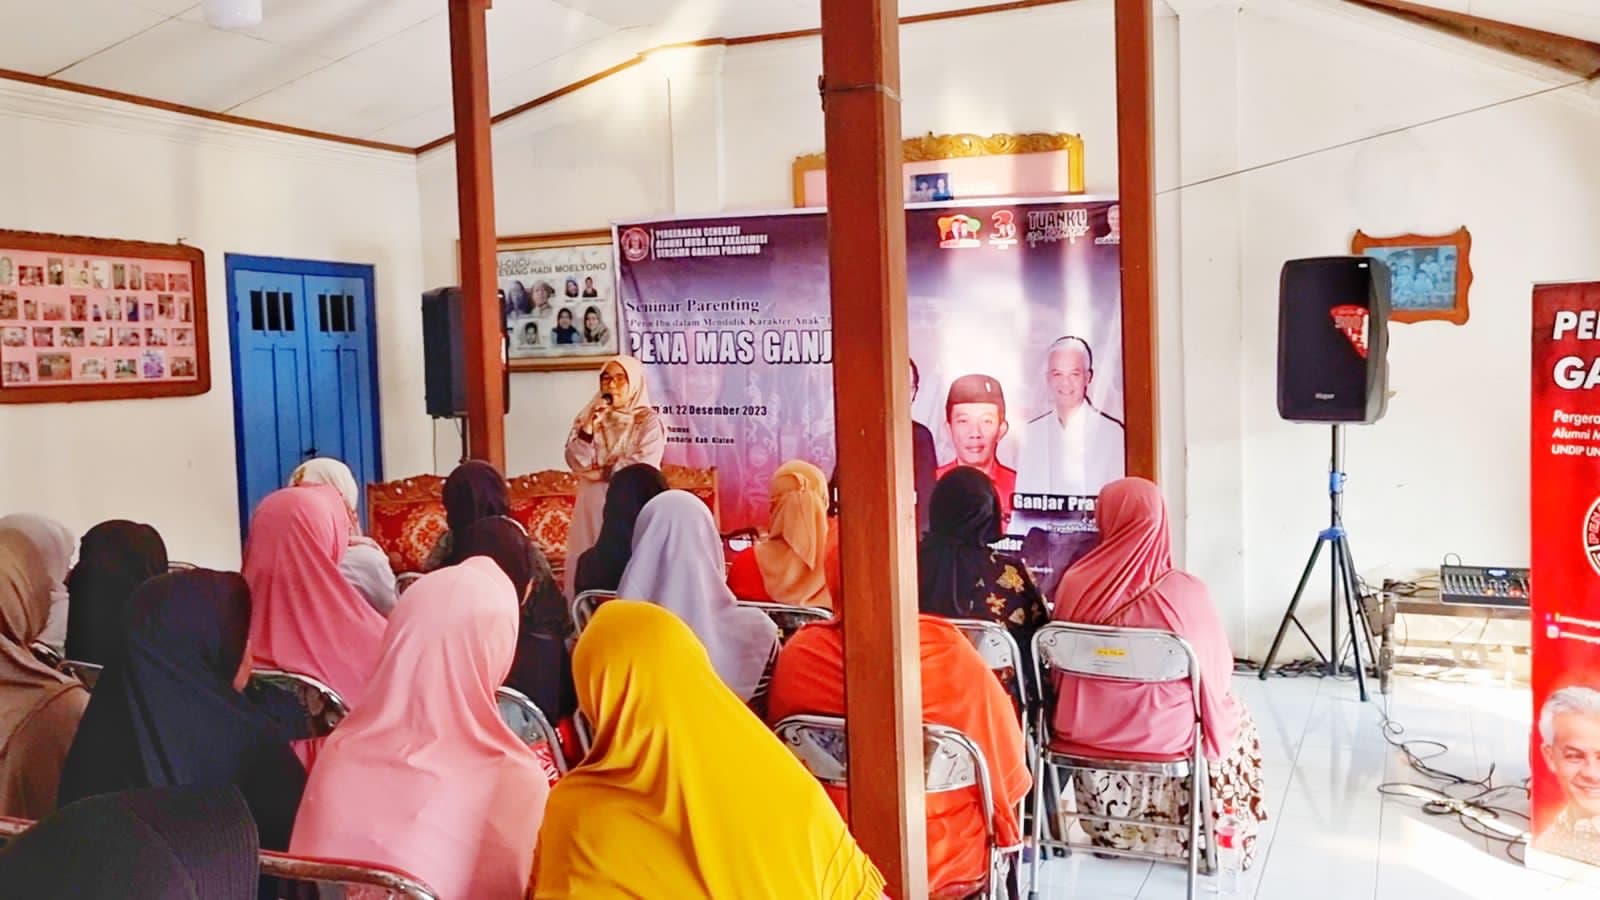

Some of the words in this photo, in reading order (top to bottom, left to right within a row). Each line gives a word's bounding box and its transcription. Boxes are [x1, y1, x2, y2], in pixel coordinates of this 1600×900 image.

[1027, 209, 1088, 230] TUANKU
[703, 226, 741, 236] GENERASI
[707, 236, 724, 246] DAN
[724, 234, 768, 245] AKADEMISI
[655, 247, 690, 258] BERSAMA
[691, 246, 721, 256] GANJAR
[721, 245, 761, 255] PRANOWO
[530, 265, 552, 274] HADI
[555, 262, 607, 273] MOELYONO
[626, 300, 680, 313] Seminar
[687, 298, 760, 313] Parenting
[673, 319, 700, 327] dalam
[703, 318, 745, 327] Mendidik
[749, 317, 790, 326] Karakter
[1553, 311, 1600, 340] PE
[630, 331, 688, 364] PENA
[694, 330, 755, 364] MAS
[676, 405, 687, 415] 22
[689, 405, 740, 416] Desember
[742, 406, 768, 416] 2023
[1552, 427, 1591, 440] Alumni
[1551, 444, 1585, 455] UNDIP
[1013, 494, 1064, 511] Ganjar
